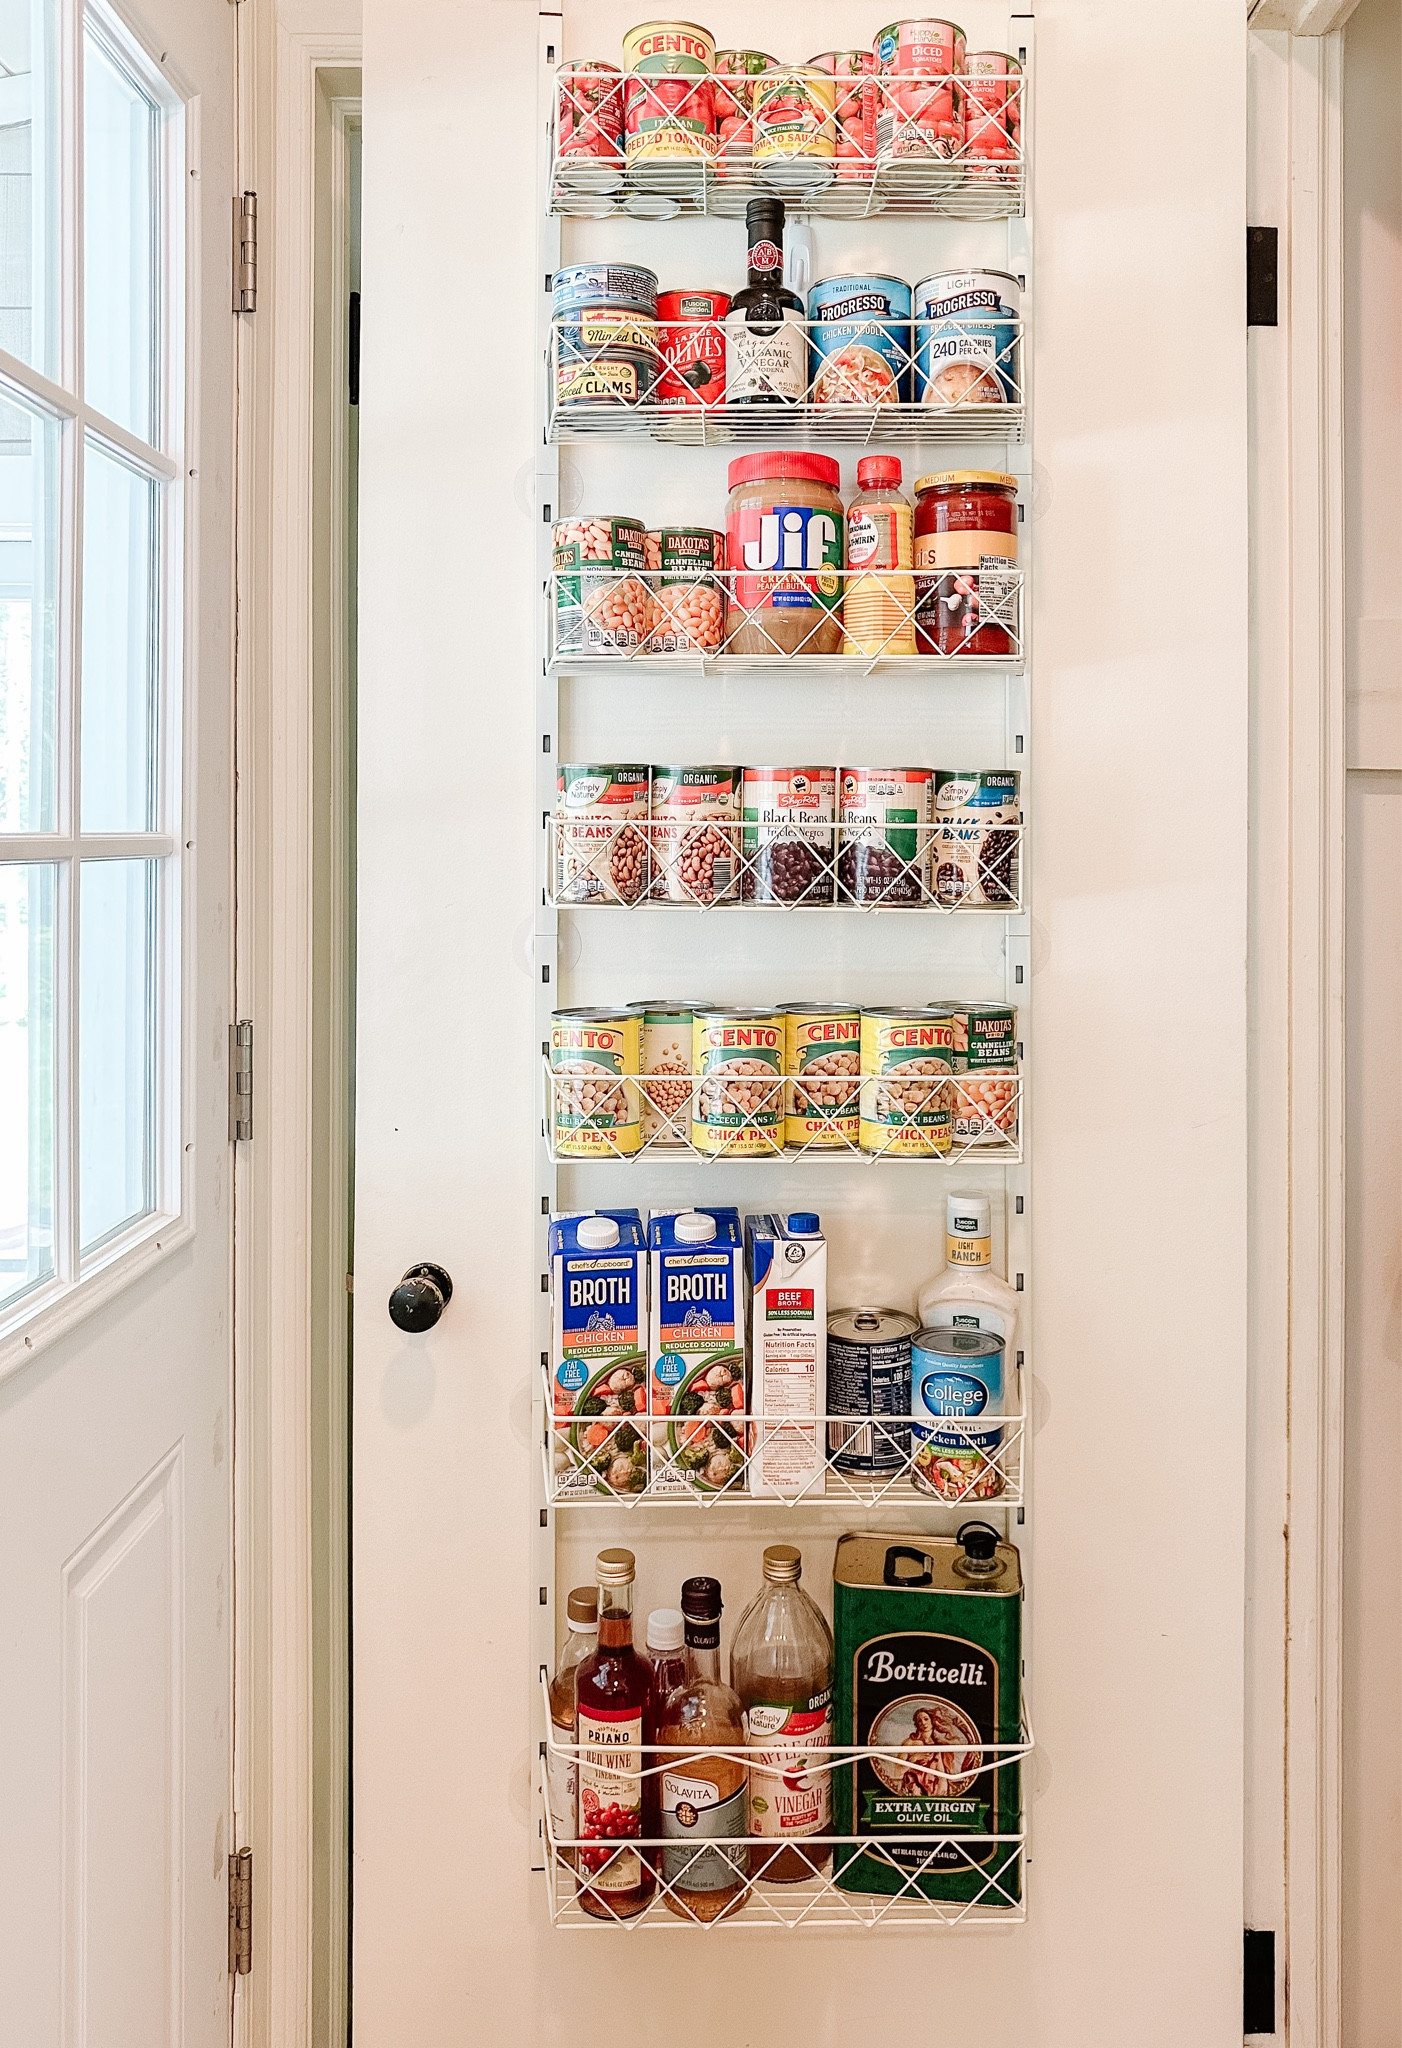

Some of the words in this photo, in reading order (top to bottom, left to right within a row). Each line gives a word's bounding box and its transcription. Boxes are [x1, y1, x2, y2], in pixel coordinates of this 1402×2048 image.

[639, 34, 707, 60] CENTO
[912, 46, 942, 57] DICED
[911, 56, 943, 64] TOMATOES
[832, 284, 872, 294] TRADITIONAL
[946, 279, 977, 290] LIGHT
[685, 300, 709, 309] Tuscan
[821, 295, 886, 321] PROGRESSO
[930, 289, 997, 317] PROGRESSO
[822, 328, 852, 342] CHICKEN
[665, 337, 723, 365] OLIVES
[933, 340, 957, 359] 240
[959, 347, 972, 355] PER
[739, 359, 790, 368] VNEGAR
[585, 381, 633, 395] CLAMS
[924, 474, 956, 486] MEDIUM
[668, 537, 711, 551] DAKOTA'S
[743, 512, 837, 571] Jif
[664, 559, 713, 568] CANNELLINI
[980, 556, 1007, 565] Nutrition
[918, 580, 936, 590] SALSA
[617, 772, 644, 783] ORGANIC
[683, 773, 718, 785] ORGANIC
[986, 776, 1015, 787] ORGANIC
[574, 783, 600, 794] Simply
[944, 786, 969, 796] Simply
[571, 791, 596, 799] Nature
[762, 809, 796, 822] Black
[799, 811, 828, 823] Beans
[847, 811, 878, 823] Beans
[572, 826, 613, 838] BEANS
[807, 1022, 860, 1042] CENT
[975, 1020, 1012, 1033] DAKOTA'S
[552, 1030, 614, 1049] CENTO
[709, 1029, 777, 1047] CENTO
[890, 1028, 952, 1046] CENTO
[977, 1049, 1010, 1057] BEANS
[719, 1116, 739, 1125] CECI
[923, 1115, 946, 1124] BEANS
[958, 1242, 974, 1250] LIGHT
[693, 1256, 728, 1265] cupboard
[951, 1249, 982, 1261] RANCH
[571, 1262, 590, 1270] chef's
[596, 1260, 630, 1269] cupboard
[570, 1277, 631, 1307] BROTH
[667, 1273, 727, 1302] BROTH
[778, 1292, 802, 1301] BEEF
[575, 1331, 625, 1344] CHICKEN
[673, 1327, 722, 1339] CHICKEN
[568, 1345, 602, 1356] REDUCED
[603, 1344, 633, 1352] SODIUM
[665, 1341, 699, 1350] REDUCED
[700, 1340, 730, 1349] SODIUM
[796, 1340, 815, 1348] Facts
[567, 1361, 578, 1370] FAT
[664, 1355, 675, 1365] FAT
[942, 1361, 959, 1369] Quality
[565, 1369, 581, 1378] FREE
[662, 1364, 678, 1373] FREE
[805, 1364, 815, 1372] 10
[924, 1382, 983, 1406] College
[940, 1404, 966, 1416] Inn
[920, 1430, 956, 1445] chcken
[693, 1635, 717, 1645] COLAVIT
[809, 1690, 831, 1710] ORGAN
[754, 1710, 781, 1724] Simply
[750, 1717, 776, 1731] Nature
[588, 1729, 630, 1744] PRIANO
[605, 1752, 632, 1769] WINE
[664, 1779, 712, 1800] COLAVITA
[774, 1788, 822, 1814] VINEGAR
[875, 1802, 922, 1813] EXTRA
[925, 1802, 976, 1813] VIRGIN
[896, 1813, 931, 1823] OLIVE
[933, 1813, 952, 1823] OIL
